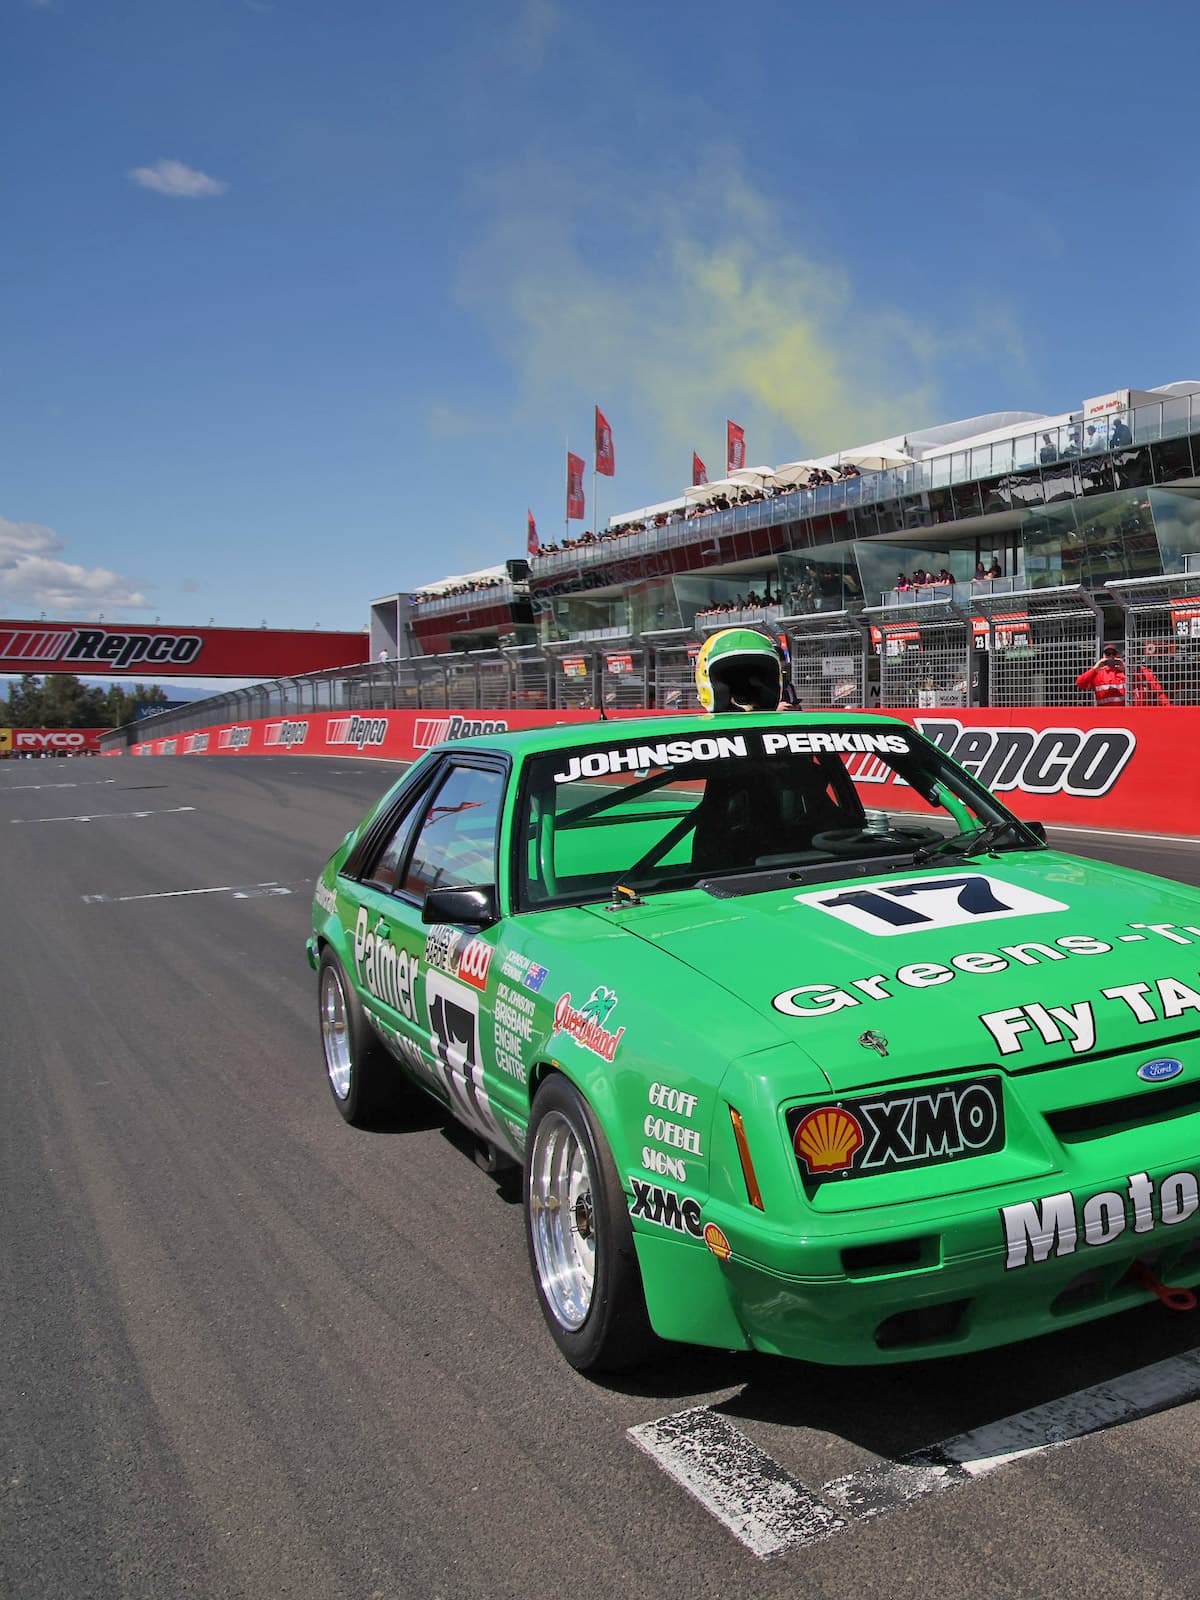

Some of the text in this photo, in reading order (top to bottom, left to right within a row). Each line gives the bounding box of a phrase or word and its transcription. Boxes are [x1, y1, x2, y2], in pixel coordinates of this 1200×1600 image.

[62, 628, 202, 669] Repco
[16, 732, 85, 746] RYCO
[348, 715, 388, 750] Repco
[553, 731, 910, 784] JOHNSON PERKINS
[819, 876, 1016, 926] 17
[505, 949, 532, 970] JOHNSON
[494, 998, 534, 1043] BRISBANE
[552, 992, 626, 1062] Queensland
[980, 1000, 1096, 1056] Fly
[494, 1022, 523, 1061] ENGINE
[495, 1047, 527, 1085] CENTRE
[648, 1082, 698, 1118] GEOFF
[643, 1114, 704, 1156] GOEBEL
[859, 1084, 997, 1168] XMO
[641, 1146, 687, 1182] SIGNS
